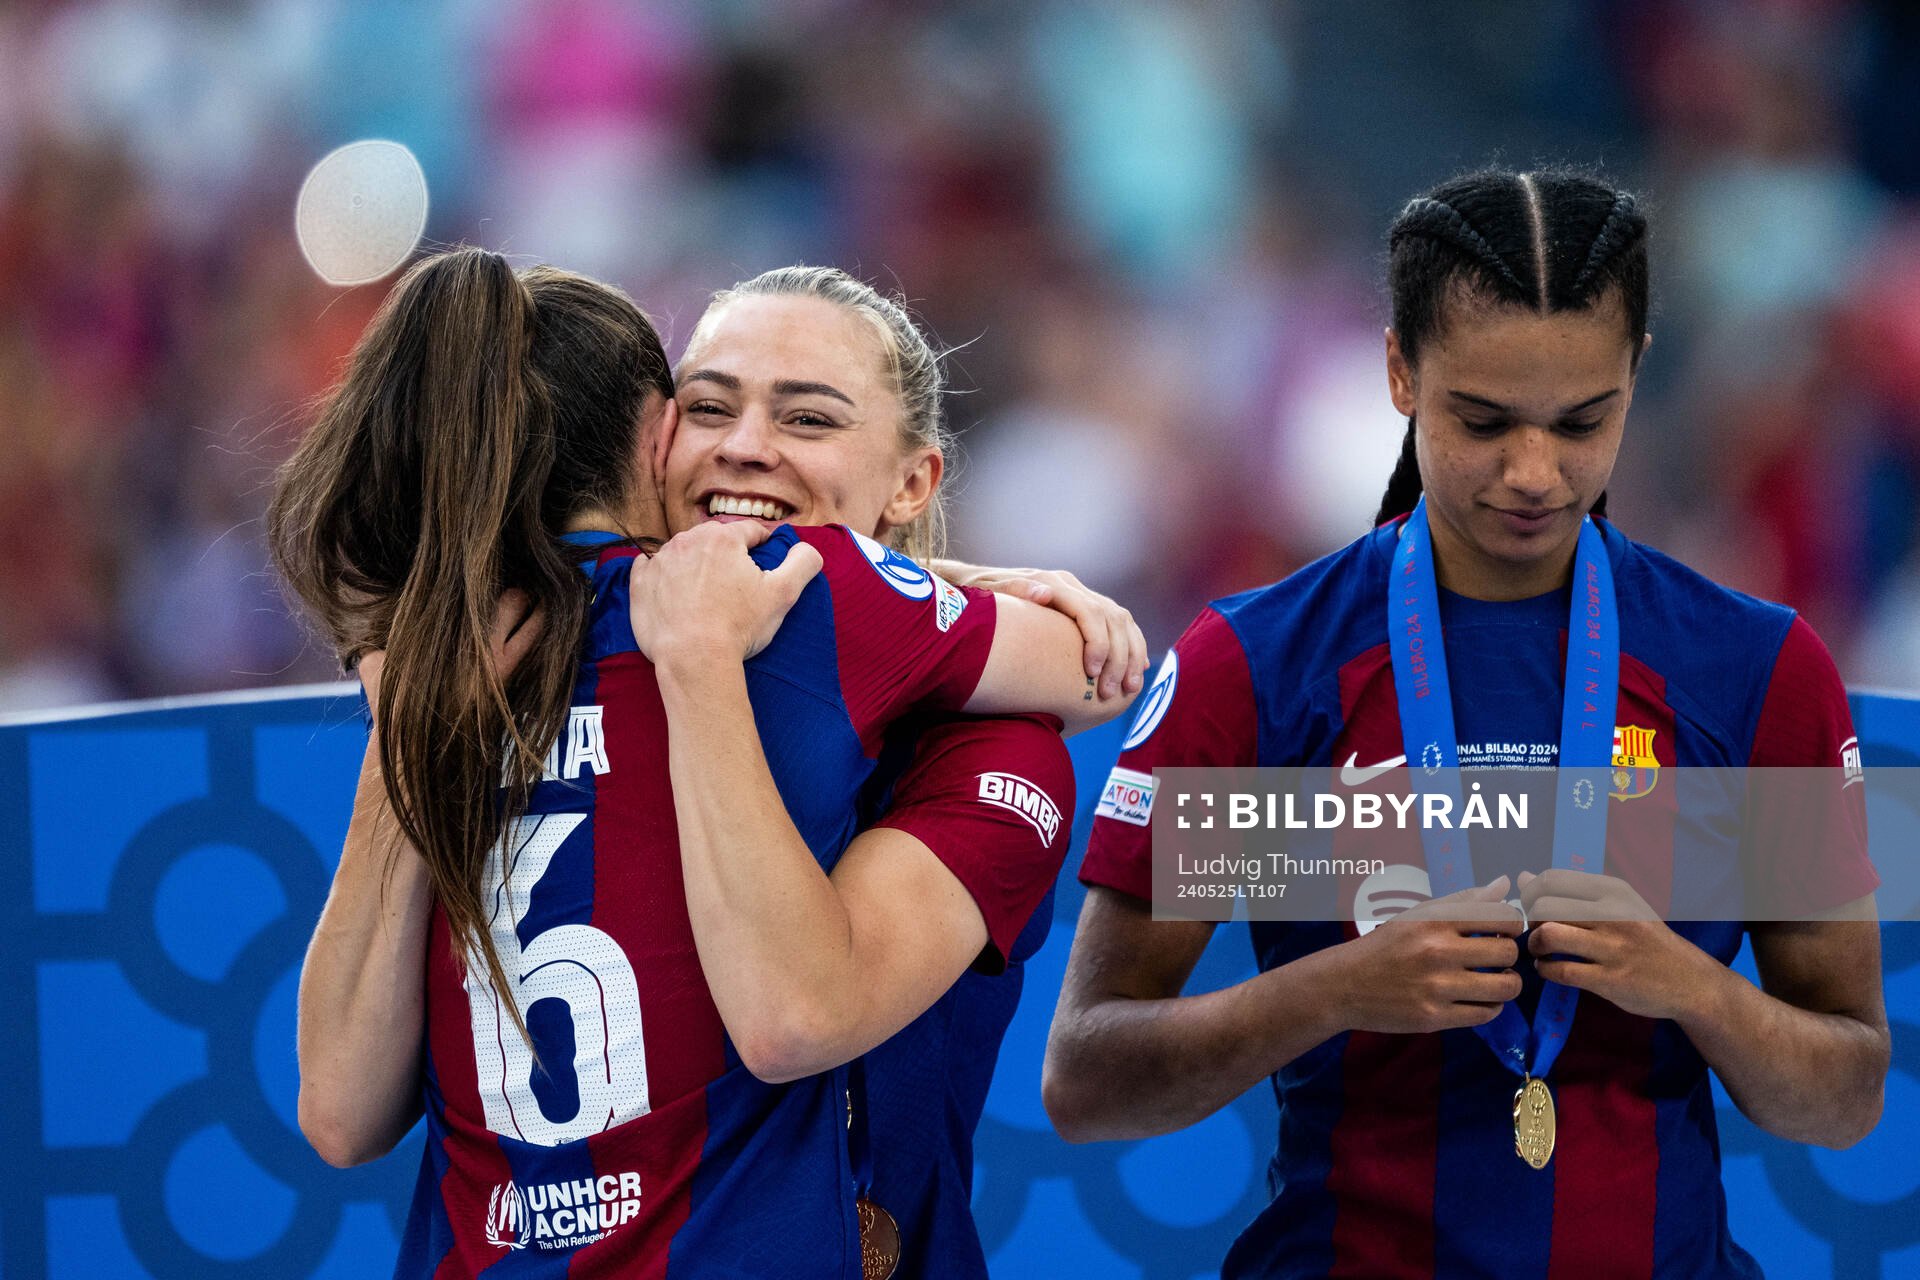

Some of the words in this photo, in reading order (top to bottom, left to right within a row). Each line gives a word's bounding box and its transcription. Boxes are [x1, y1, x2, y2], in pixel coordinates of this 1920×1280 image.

[1581, 650, 1601, 729] FINAL
[1458, 756, 1471, 764] SAN
[1472, 754, 1495, 763] MAMÉS
[1495, 755, 1524, 763] STADIUM
[1528, 756, 1536, 764] 25
[1537, 756, 1551, 764] MAY
[1485, 743, 1528, 755] BILBAO
[1529, 744, 1559, 756] 2024
[978, 775, 1060, 847] BIMBO
[464, 812, 651, 1148] 6
[528, 1171, 642, 1212] UNHCR
[537, 1240, 553, 1250] The
[554, 1236, 569, 1249] UN
[570, 1231, 605, 1246] Refugee
